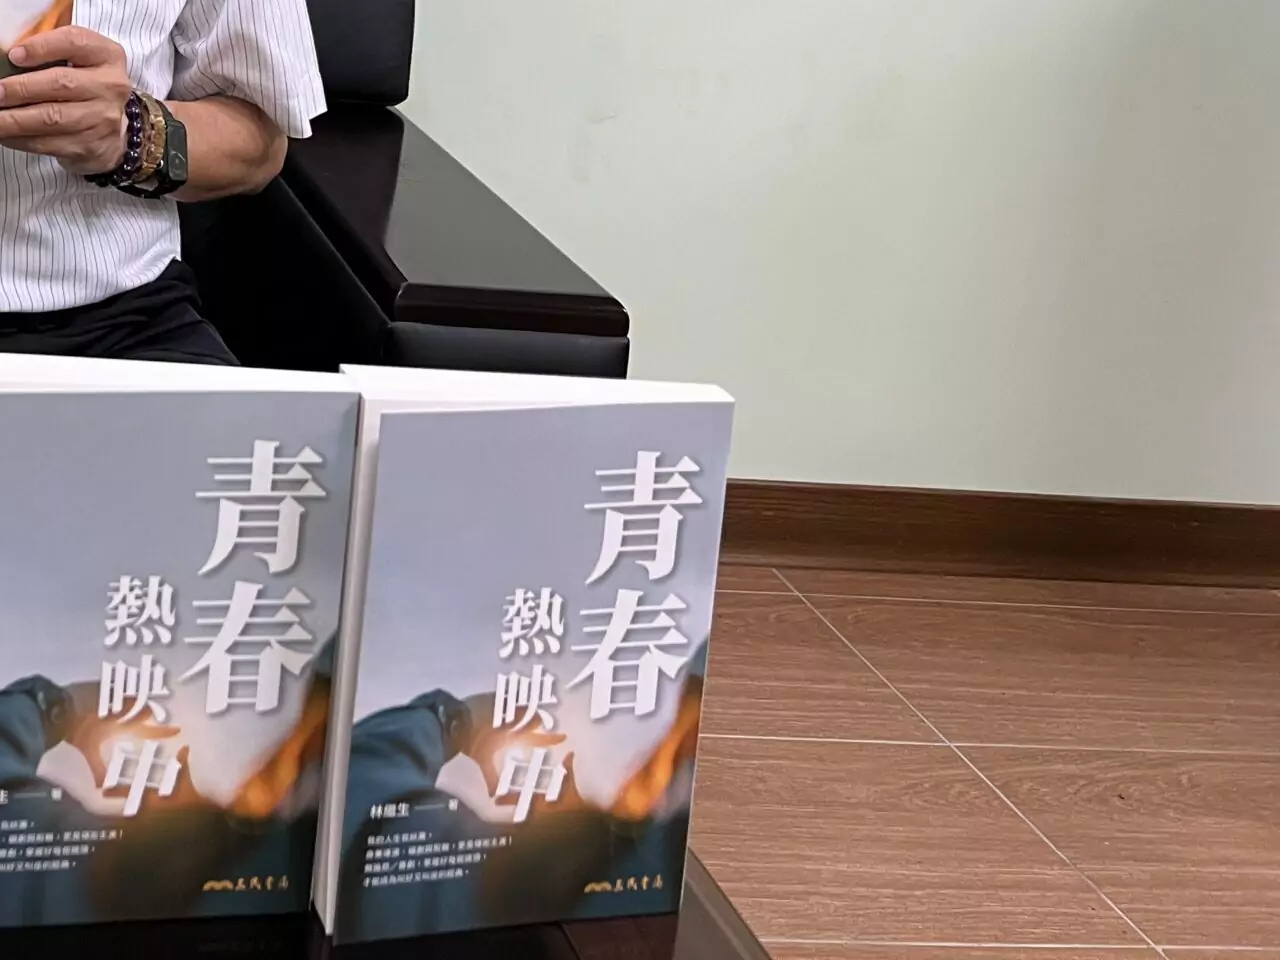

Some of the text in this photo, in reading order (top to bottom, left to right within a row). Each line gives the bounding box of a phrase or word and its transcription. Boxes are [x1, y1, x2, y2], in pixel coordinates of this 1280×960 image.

[97, 574, 181, 817] 熱映中
[179, 439, 327, 714] 青春
[565, 451, 702, 720] 青春
[493, 587, 568, 823] 熱映中
